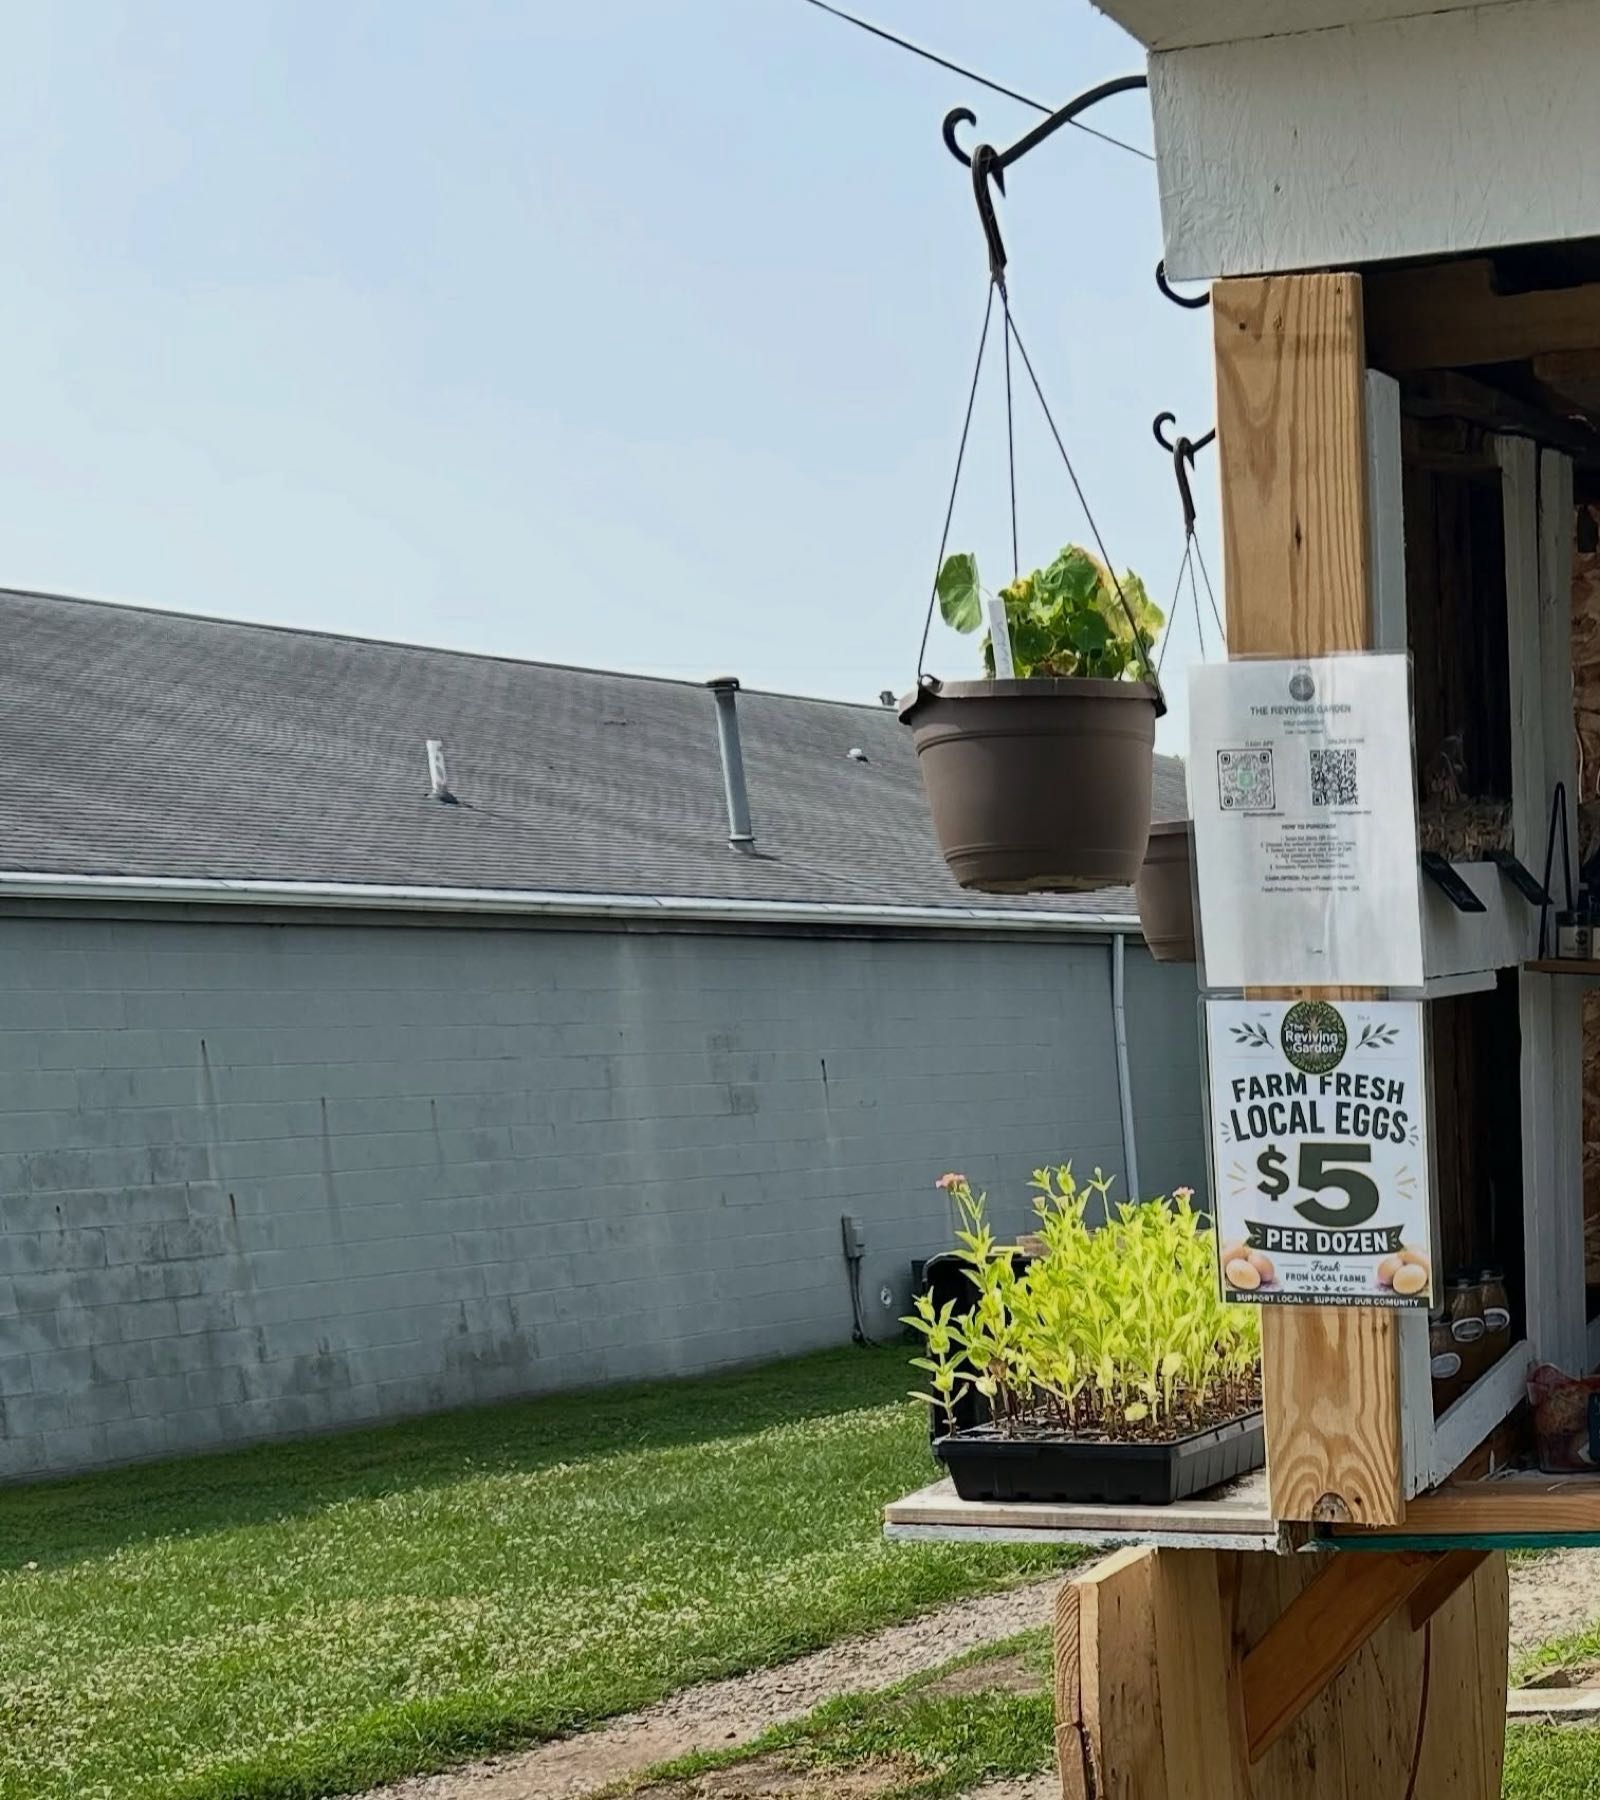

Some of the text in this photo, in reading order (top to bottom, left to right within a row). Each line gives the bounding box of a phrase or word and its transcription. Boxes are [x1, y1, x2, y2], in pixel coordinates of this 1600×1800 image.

[1250, 704, 1351, 716] THE REVIVING GARDEN
[1289, 1023, 1304, 1031] The
[1285, 1030, 1338, 1045] Reviving
[1293, 1042, 1337, 1053] Garden
[1231, 1072, 1405, 1105] FARM FRESH
[1230, 1100, 1408, 1144] LOCAL EGGS
[1256, 1142, 1379, 1228] $5
[1266, 1229, 1388, 1253] PER DOZEN
[1310, 1260, 1341, 1272] Fresh
[1285, 1272, 1366, 1283] FROM LOCAL FARMS
[1236, 1293, 1275, 1303] SUPPORT
[1276, 1295, 1303, 1304] LOCAL
[1314, 1296, 1352, 1305] SUPPORT
[1354, 1297, 1372, 1306] OUR
